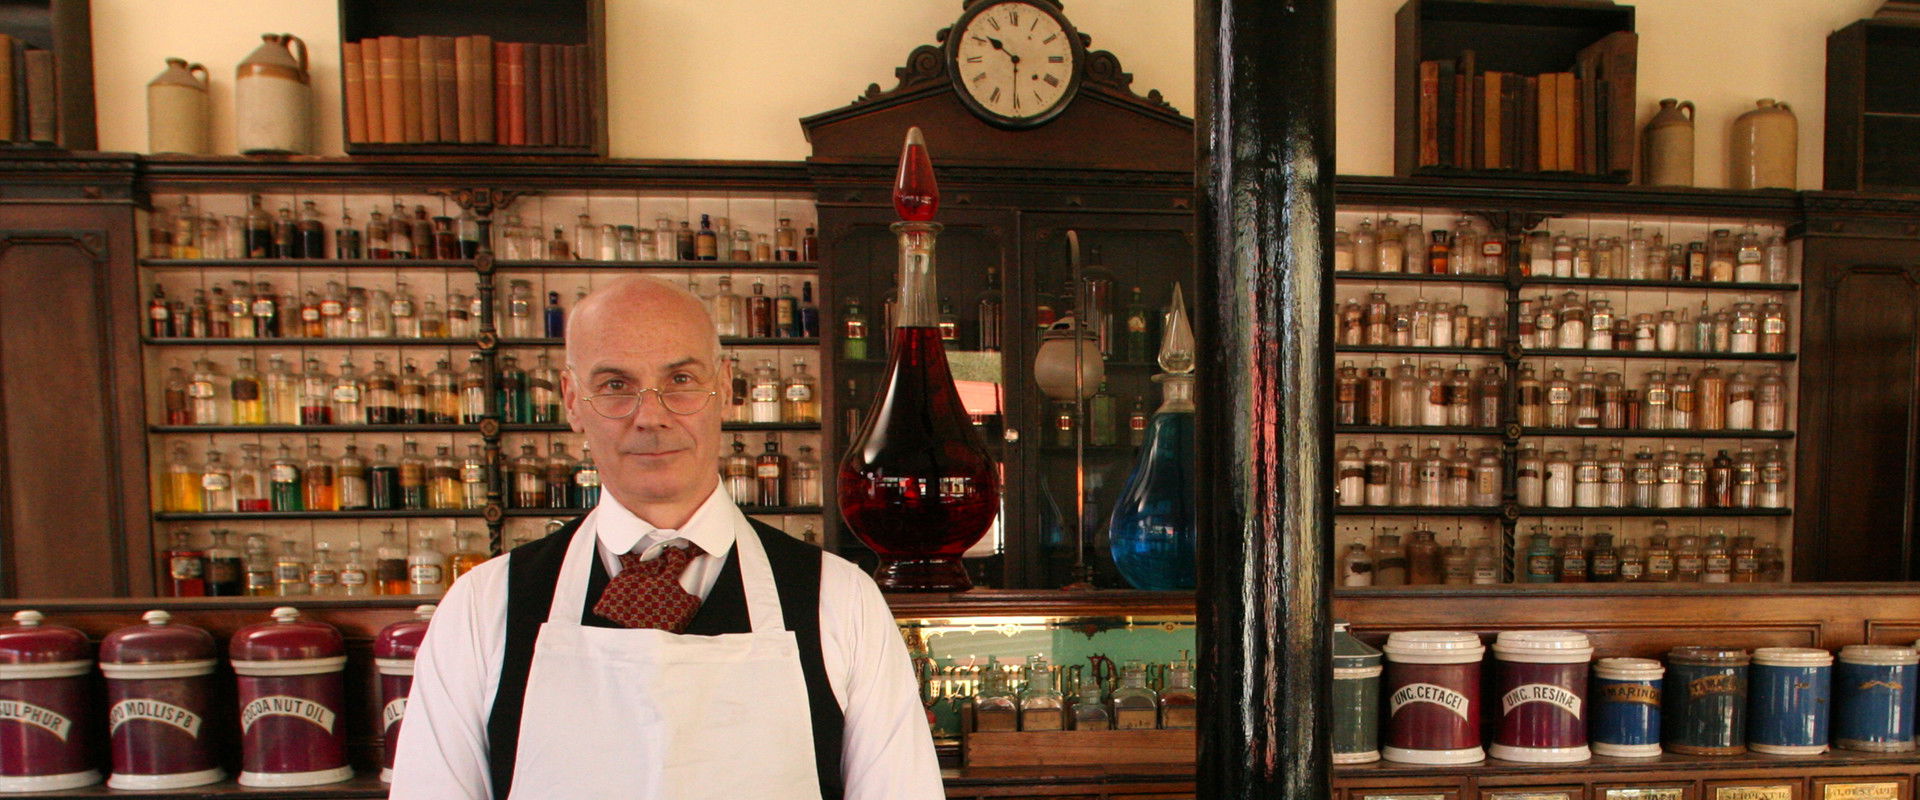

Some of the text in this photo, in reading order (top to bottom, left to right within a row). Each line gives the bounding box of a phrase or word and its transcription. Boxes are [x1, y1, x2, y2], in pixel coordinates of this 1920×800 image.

[1417, 686, 1463, 709] CETACEI
[0, 702, 62, 731] ULPHUR
[273, 698, 302, 714] NUT
[305, 703, 325, 724] OIL
